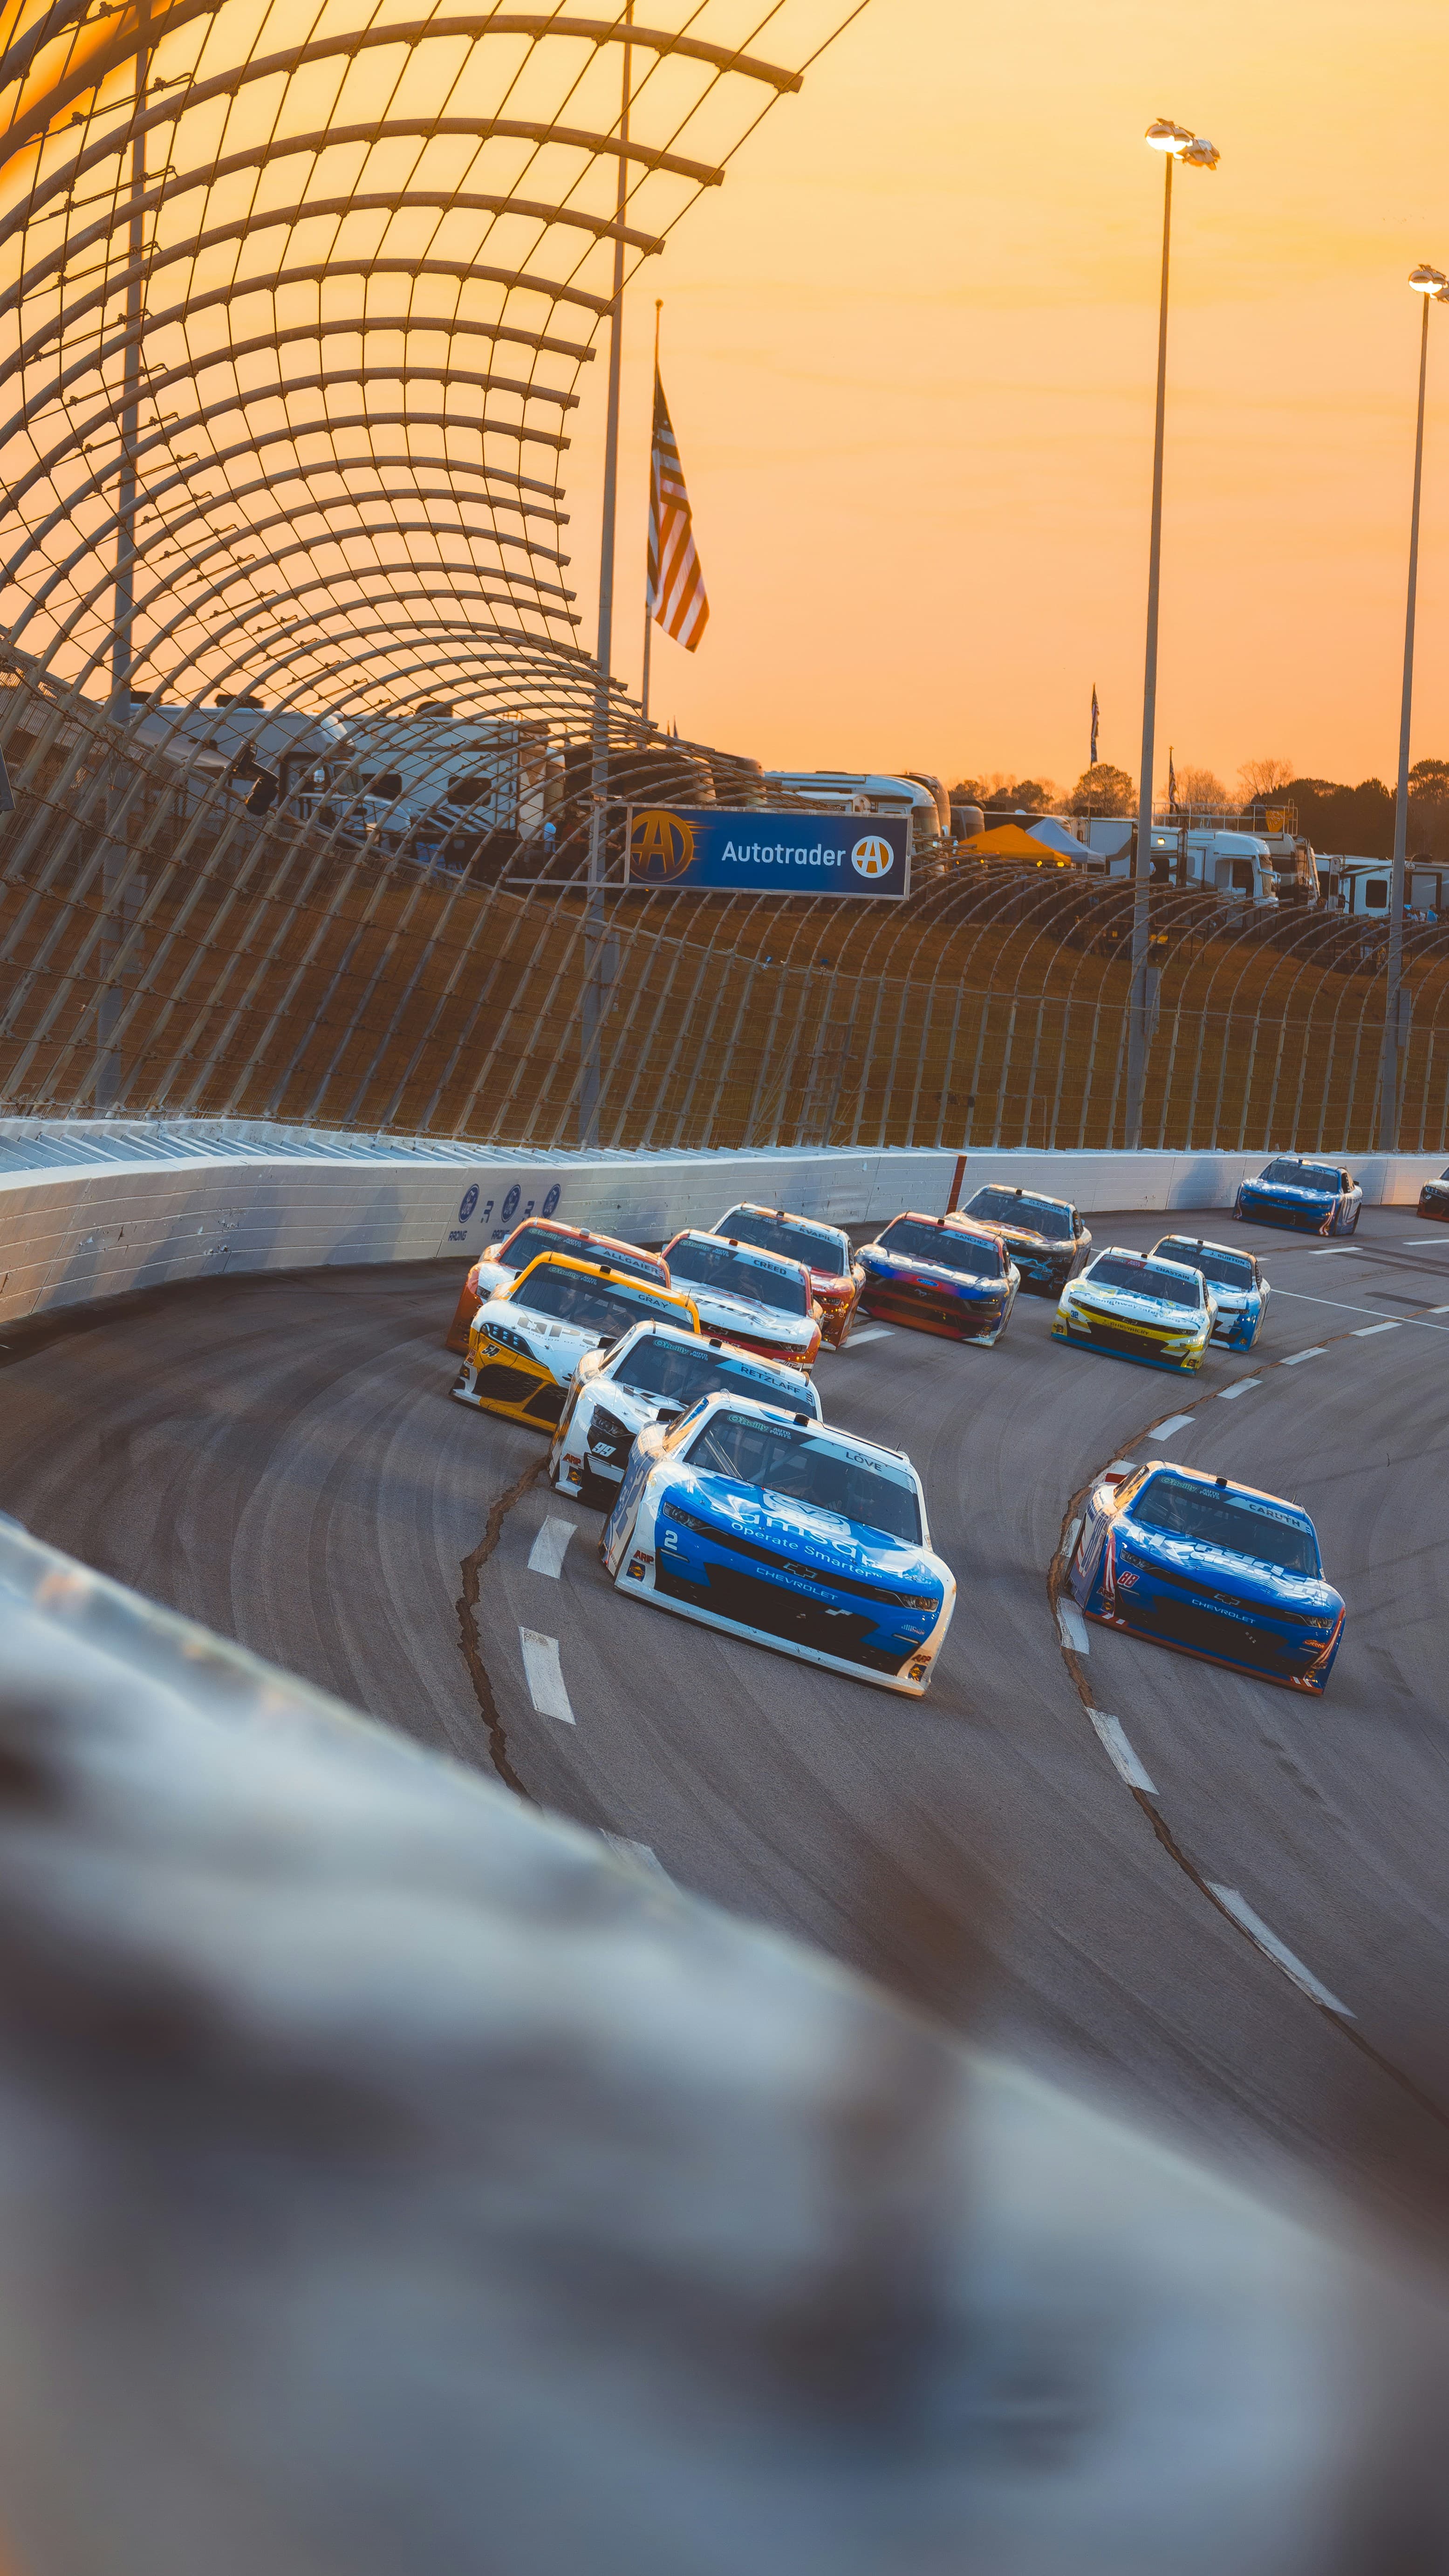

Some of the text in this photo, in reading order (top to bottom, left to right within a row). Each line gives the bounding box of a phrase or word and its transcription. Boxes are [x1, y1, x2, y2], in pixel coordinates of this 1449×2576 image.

[722, 841, 846, 866] Autotrader
[448, 1231, 467, 1241] RACING
[800, 1227, 833, 1242] KVAPIL
[955, 1233, 988, 1247] SANCHEZ
[603, 1250, 658, 1274] ALLGAIER
[754, 1259, 787, 1275] CREED
[1217, 1254, 1245, 1265] BURTON
[1156, 1266, 1189, 1280] CHASTAIN
[638, 1294, 669, 1309] GRAY
[1071, 1310, 1079, 1319] 32
[741, 1367, 801, 1394] RETZLAFF
[770, 1430, 792, 1439] PARTS
[773, 1427, 791, 1436] AUTO
[592, 1442, 616, 1457] 99
[562, 1453, 581, 1465] ARP
[846, 1452, 882, 1472] LOVE
[1200, 1490, 1220, 1500] PARTS
[1249, 1503, 1300, 1527] CARUTH
[664, 1530, 678, 1551] 2
[731, 1522, 798, 1549] Operate
[633, 1549, 655, 1563] ARP
[756, 1567, 838, 1600] CHEVROLET
[1117, 1571, 1140, 1588] 88
[1192, 1599, 1256, 1624] CHEVROLET
